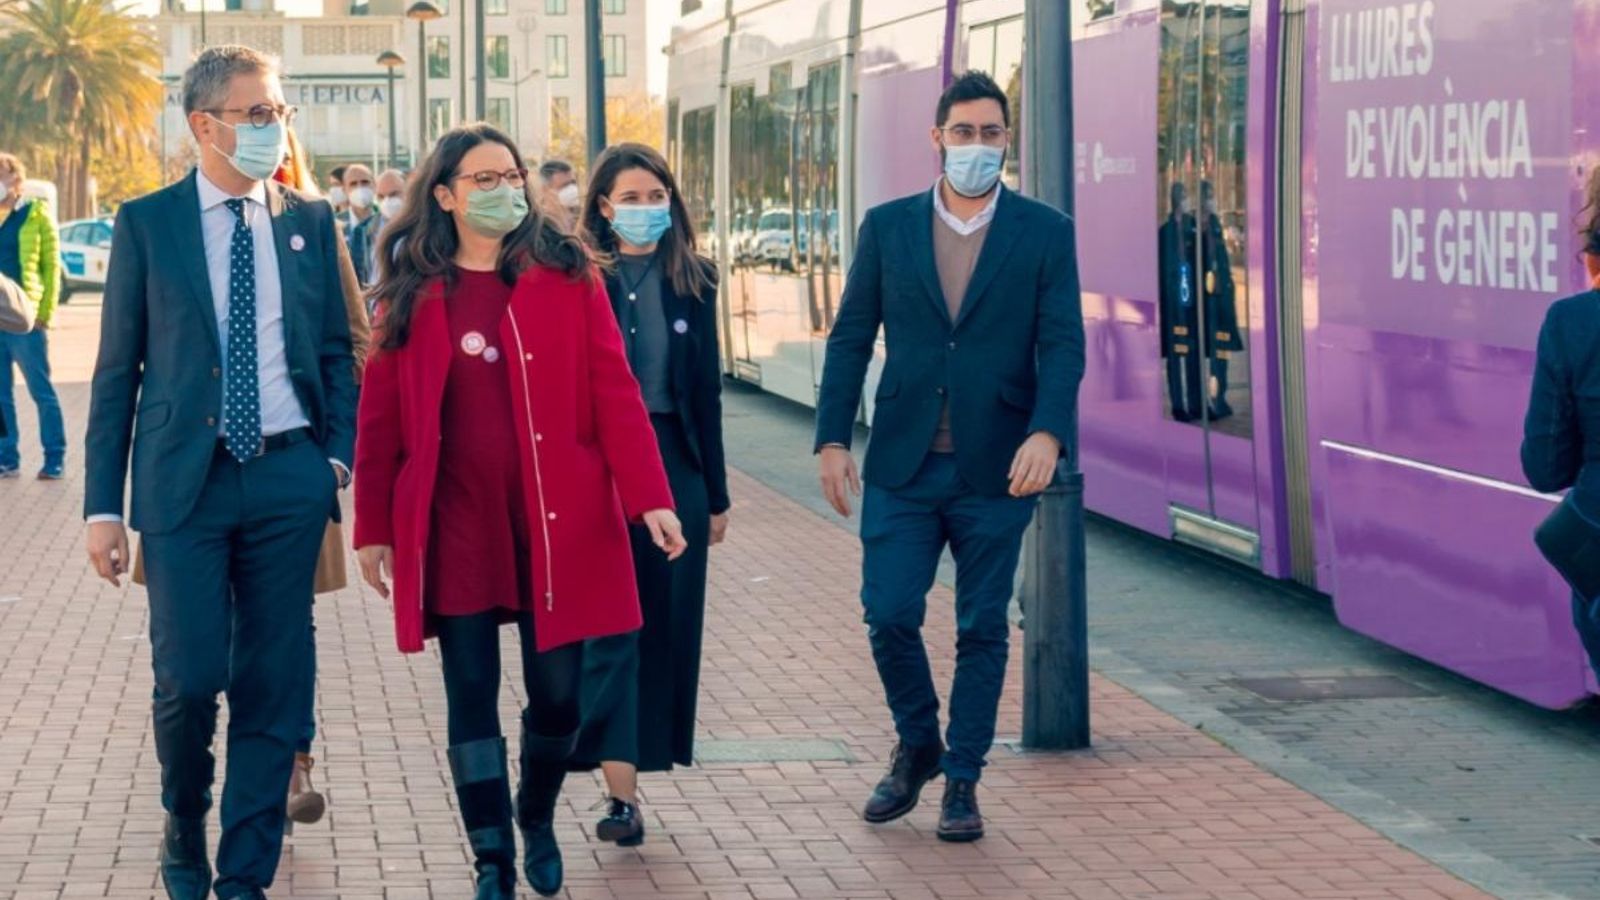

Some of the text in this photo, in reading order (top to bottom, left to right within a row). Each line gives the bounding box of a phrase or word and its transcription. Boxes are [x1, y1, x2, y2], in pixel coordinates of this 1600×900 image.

[1330, 0, 1434, 83] LLIURES
[1346, 77, 1534, 180] DE VIOLÈNCIA
[1391, 182, 1558, 293] DE GÈNERE
